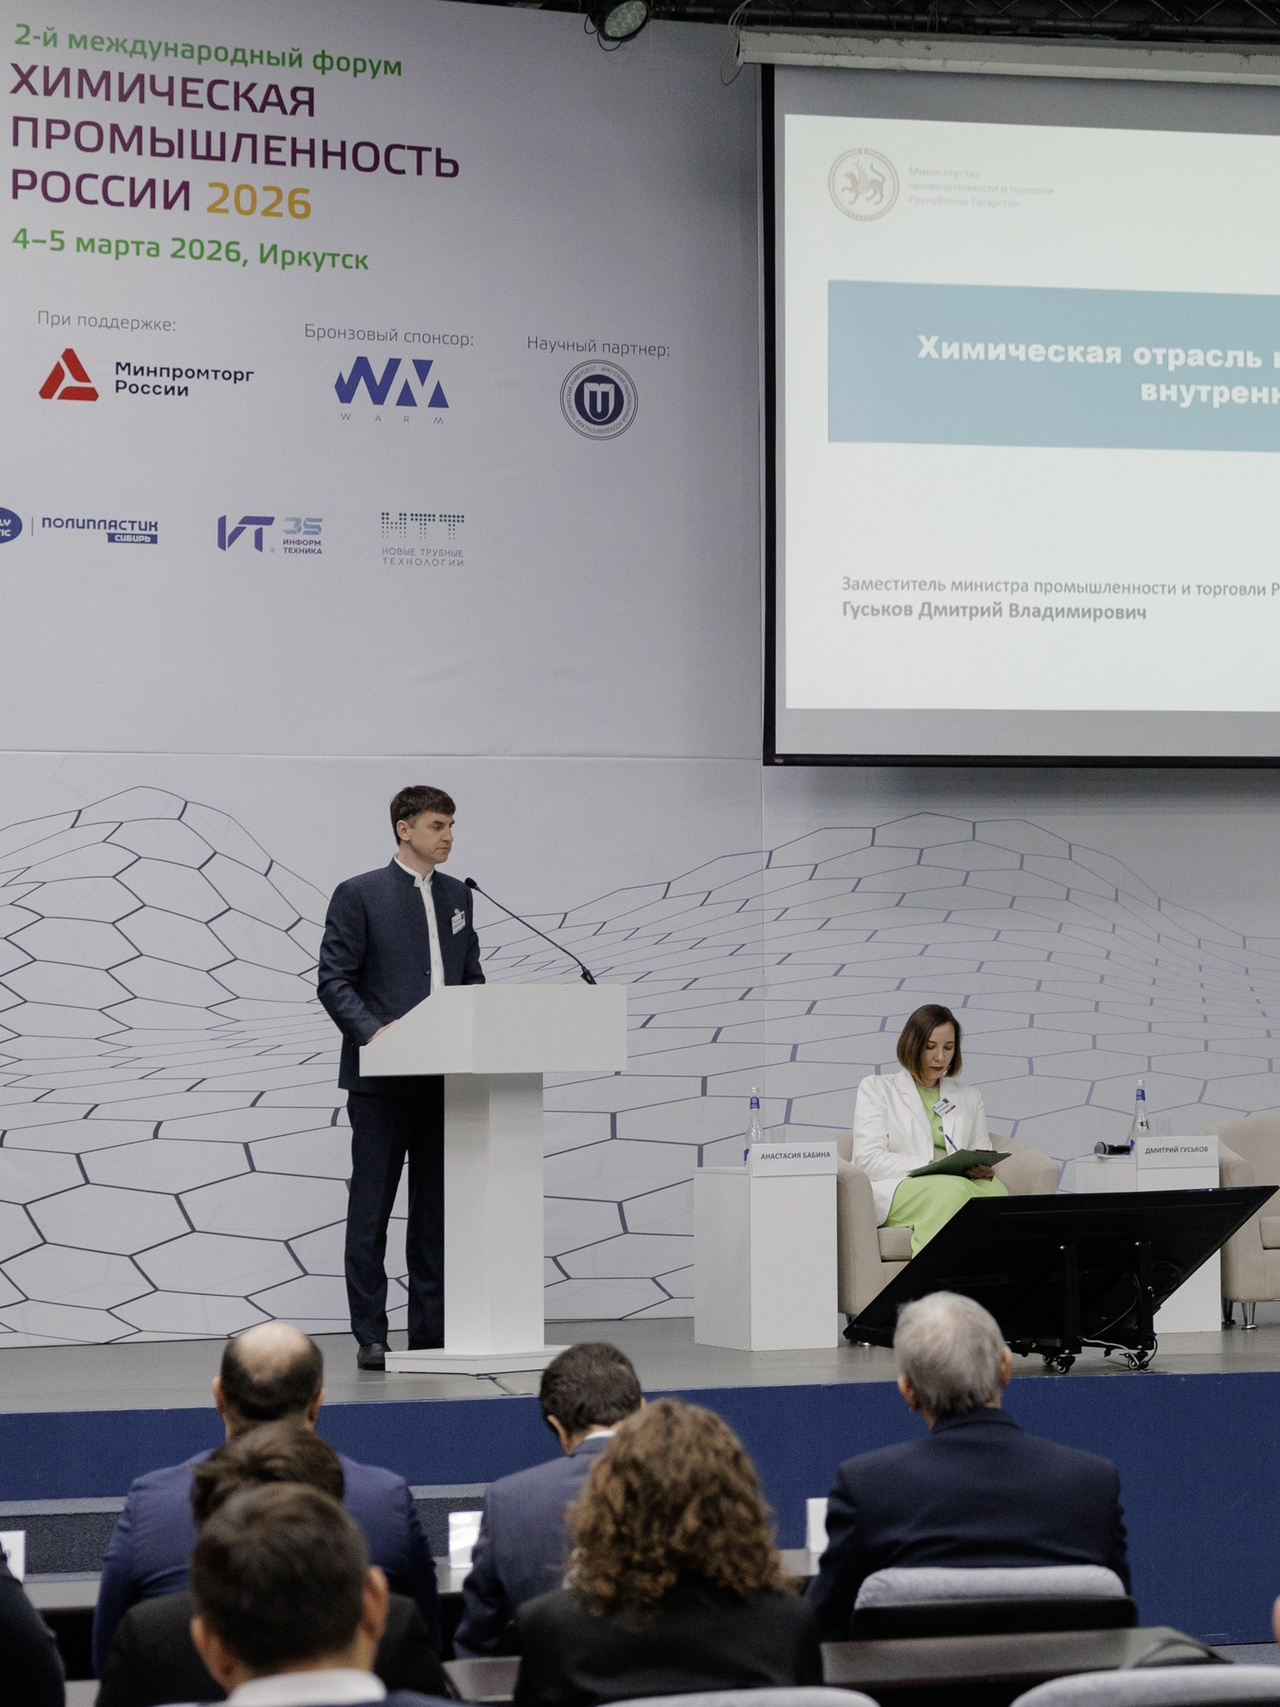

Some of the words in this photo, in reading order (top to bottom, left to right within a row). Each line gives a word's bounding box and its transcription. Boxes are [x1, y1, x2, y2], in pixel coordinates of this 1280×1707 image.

[14, 23, 59, 48] 2-й
[67, 32, 303, 69] международный
[312, 49, 402, 78] форум
[9, 62, 316, 117] ХИМИЧЕСКАЯ
[12, 116, 460, 178] ПРОМЫШЛЕННОСТЬ
[12, 169, 191, 211] РОССИИ
[206, 182, 312, 219] 2026
[75, 236, 161, 260] марта
[170, 237, 248, 267] 2026,
[259, 243, 369, 272] Иркутск
[37, 310, 71, 327] При
[77, 315, 177, 332] поддержке:
[304, 323, 398, 342] Бронзовый
[403, 328, 475, 347] спонсор:
[526, 335, 596, 352] Научный
[602, 342, 670, 358] партнер:
[918, 335, 1122, 363] Химическая
[1133, 346, 1263, 371] отрасль
[114, 361, 255, 384] Минпромторг
[114, 380, 189, 397] России
[340, 412, 445, 425] WARM
[42, 517, 158, 531] ПОЛИПЛАСТИК
[114, 533, 152, 544] СИБИРЬ
[282, 538, 322, 548] ИНФОРМ
[283, 547, 323, 555] ТЕХНИКА
[382, 547, 416, 557] НОВЫЕ
[420, 548, 464, 558] ТРУБНЫЕ
[382, 557, 465, 568] ТЕХНОЛОГИИ
[841, 576, 947, 593] Заместитель
[950, 579, 1029, 596] министра
[1033, 580, 1177, 597] промышленности
[1181, 583, 1192, 596] и
[1195, 584, 1266, 599] торговли
[841, 600, 915, 621] Гуськов
[918, 600, 1003, 621] Дмитрий
[1008, 602, 1147, 621] Владимирович
[761, 1152, 801, 1160] АНАСТАСИЯ
[802, 1151, 831, 1159] БАБИНА
[1145, 1146, 1179, 1155] ДМИТРИЙ
